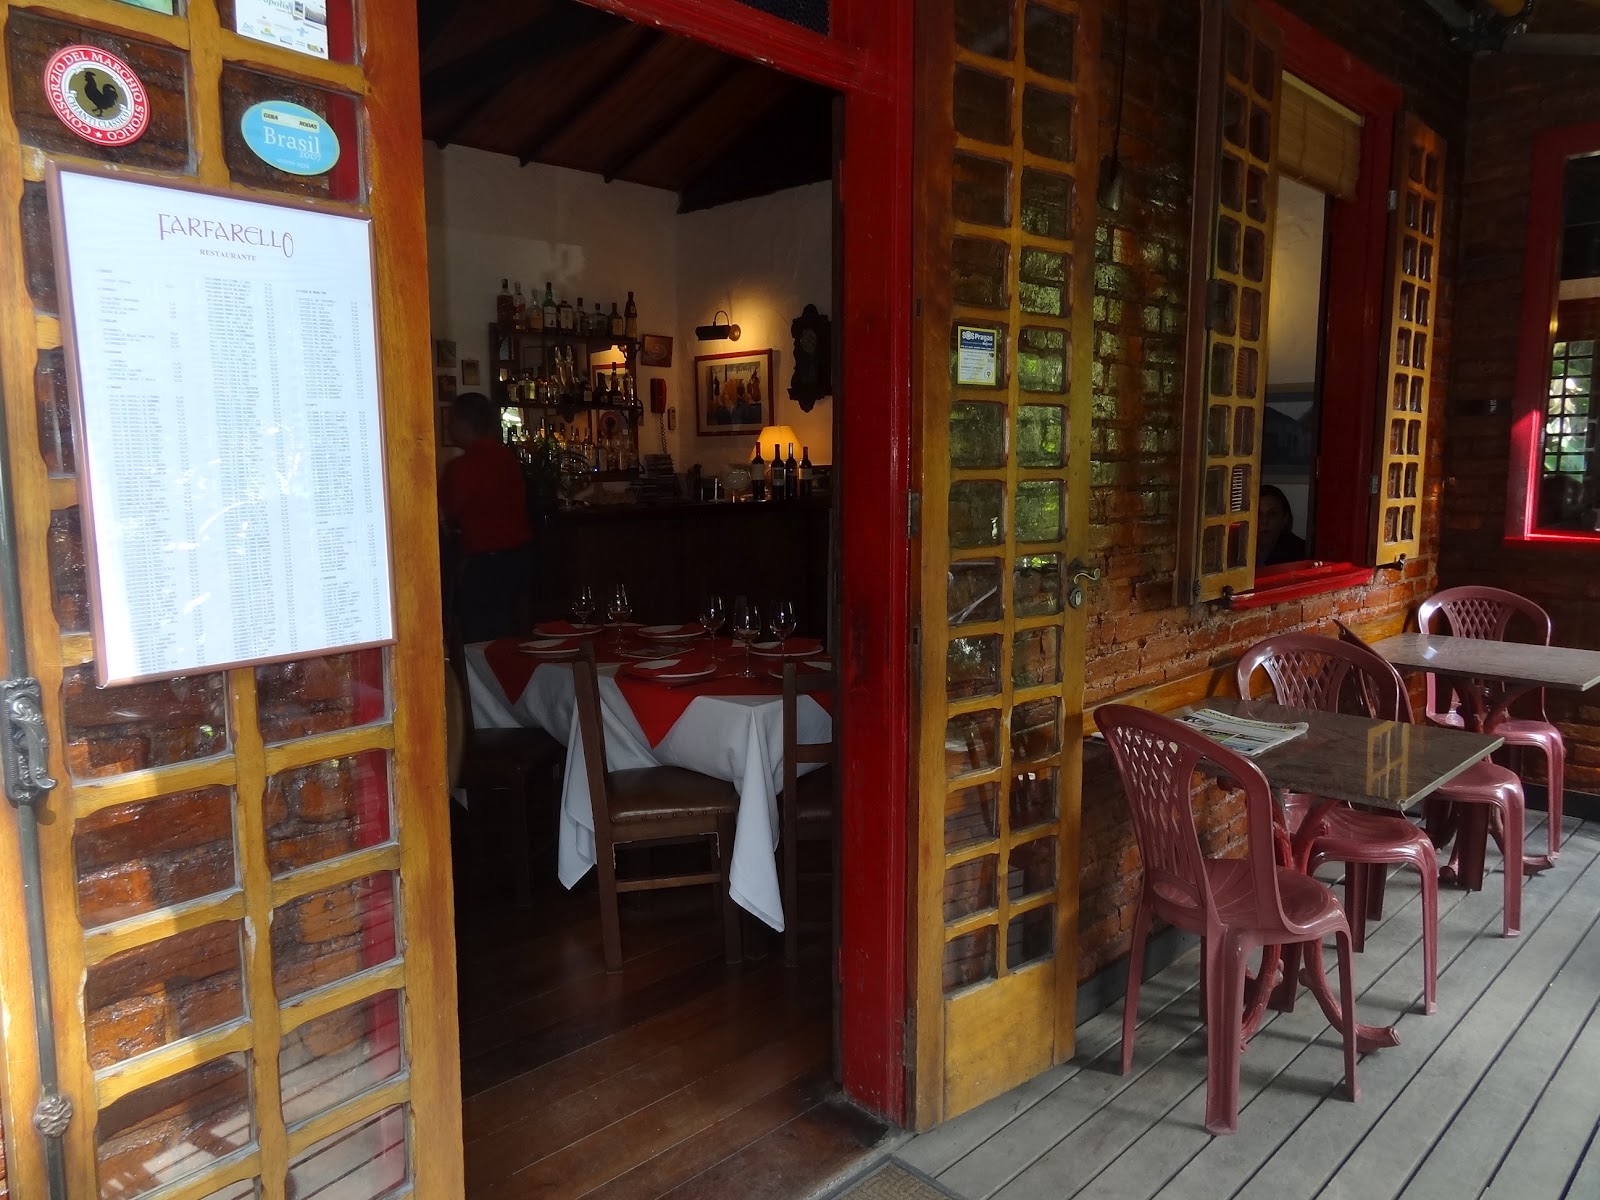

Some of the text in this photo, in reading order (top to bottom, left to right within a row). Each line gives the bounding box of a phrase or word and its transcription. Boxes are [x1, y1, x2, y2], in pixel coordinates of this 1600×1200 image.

[51, 51, 144, 141] CONSORZIO DEL MARCHIO STORICO
[299, 120, 318, 130] RODAS
[263, 125, 321, 155] Brasil
[299, 152, 322, 162] 2007
[158, 213, 294, 258] FARFARELLO
[199, 248, 257, 261] RESTAURANTE
[962, 331, 993, 342] SOS Pragas
